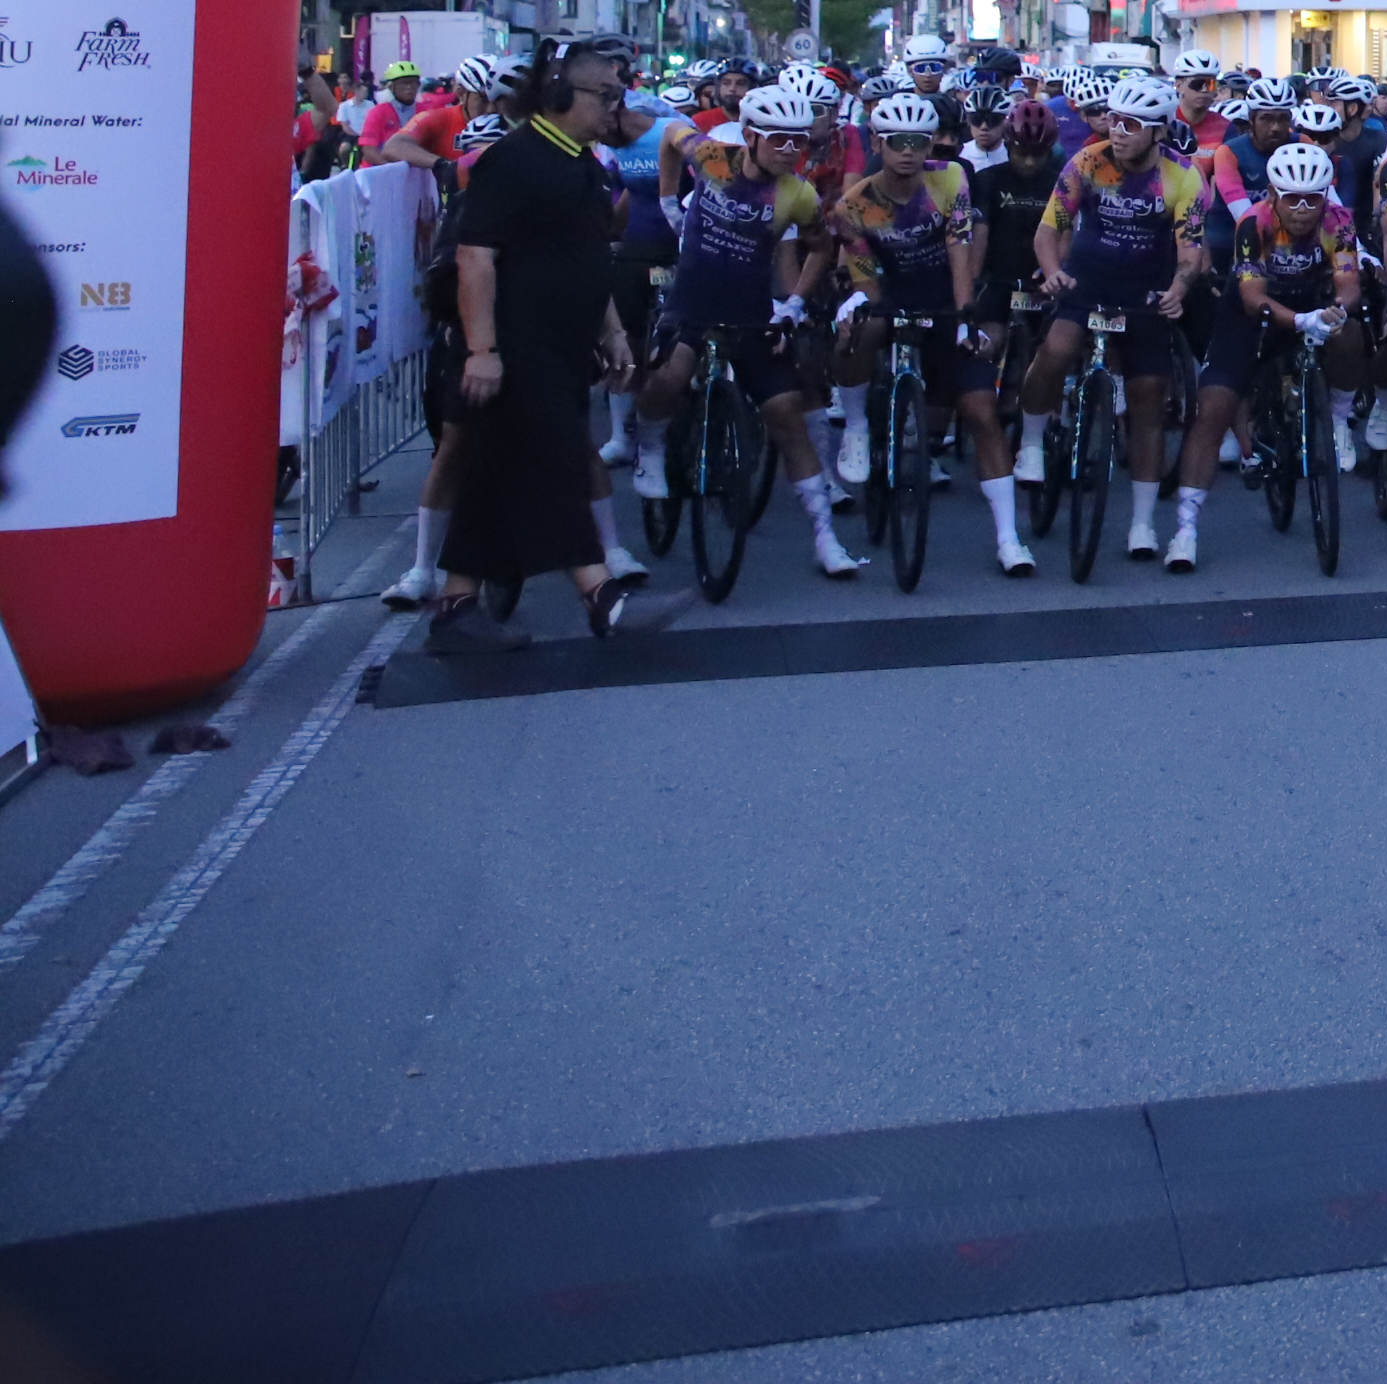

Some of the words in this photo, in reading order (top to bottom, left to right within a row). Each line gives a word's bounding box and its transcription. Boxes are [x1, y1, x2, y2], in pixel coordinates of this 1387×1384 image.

[795, 39, 811, 51] 60
[24, 115, 85, 127] Mineral
[91, 115, 143, 127] Water:
[54, 156, 77, 172] Le
[16, 170, 98, 185] Minerale
[80, 281, 131, 307] N8
[98, 349, 139, 357] GLOBAL
[98, 356, 147, 364] SYNERGY
[98, 364, 139, 372] SPORTS
[85, 424, 137, 437] KTM
